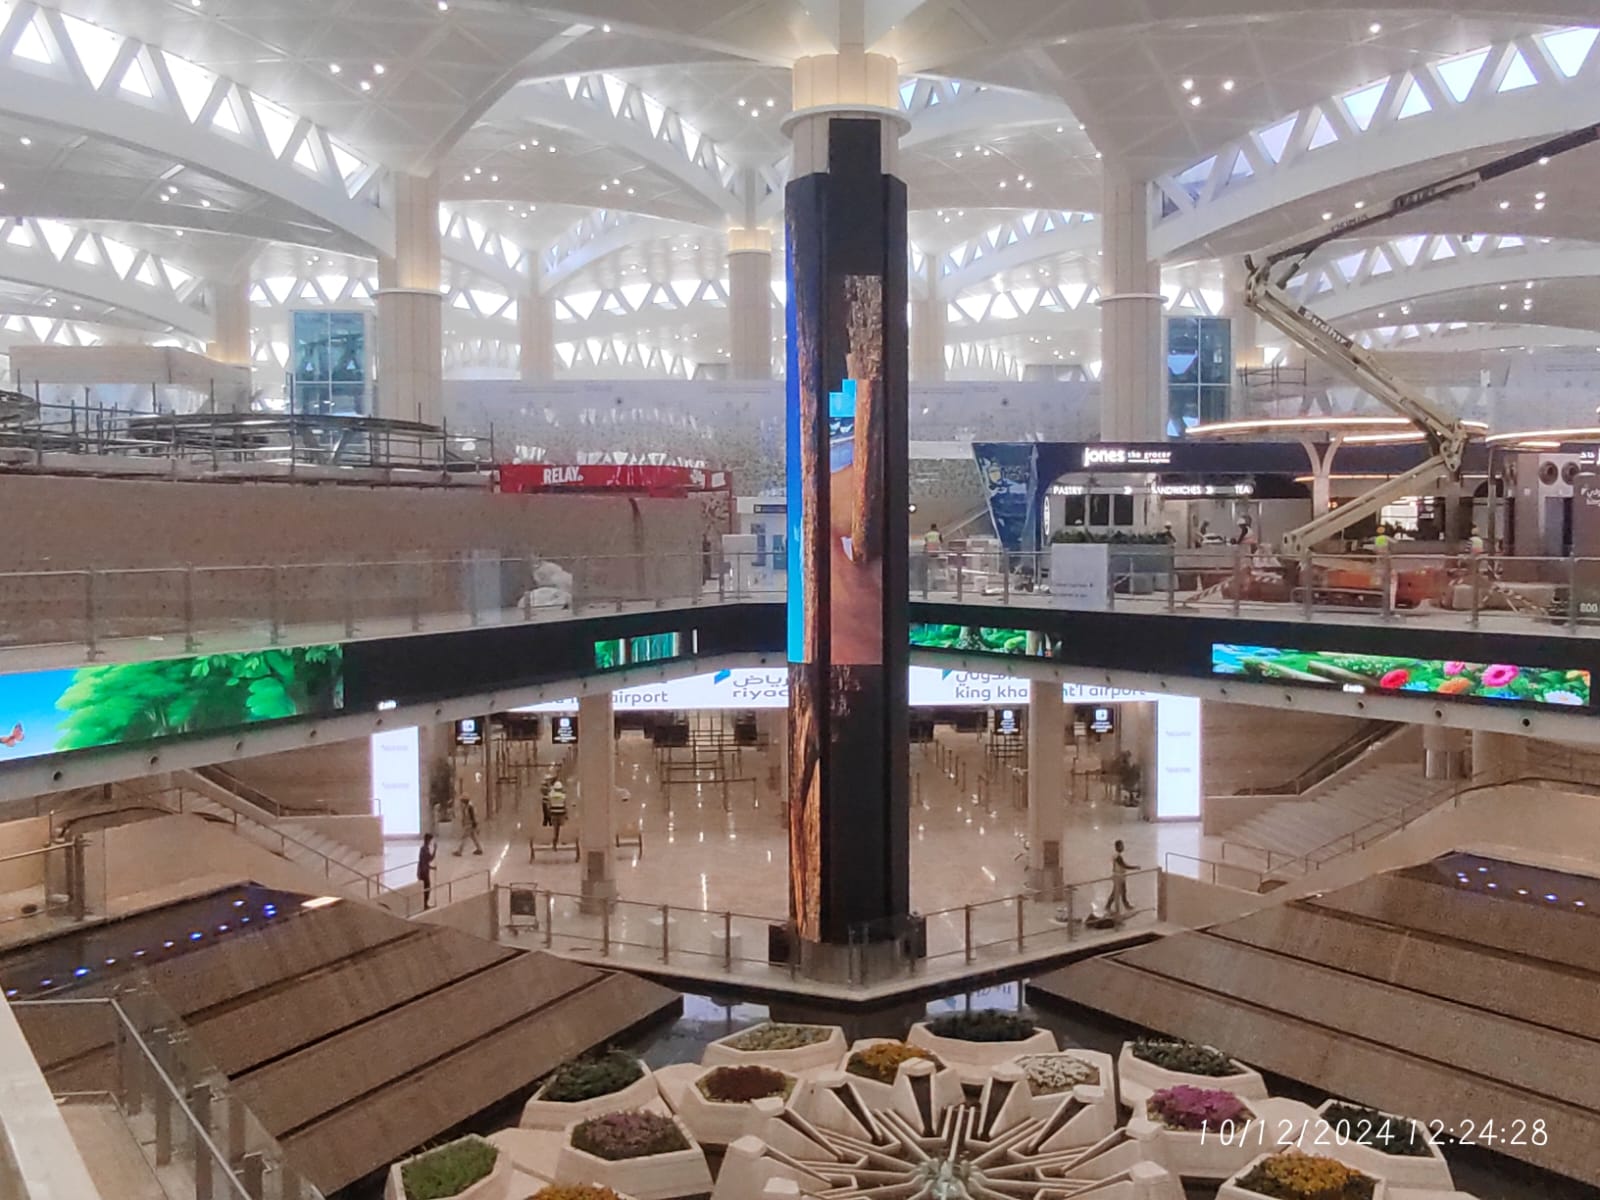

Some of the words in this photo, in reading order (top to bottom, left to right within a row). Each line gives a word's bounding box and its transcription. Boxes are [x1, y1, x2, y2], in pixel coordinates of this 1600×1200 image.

[1083, 446, 1127, 467] jones
[543, 466, 580, 484] RELAY
[955, 685, 991, 701] king
